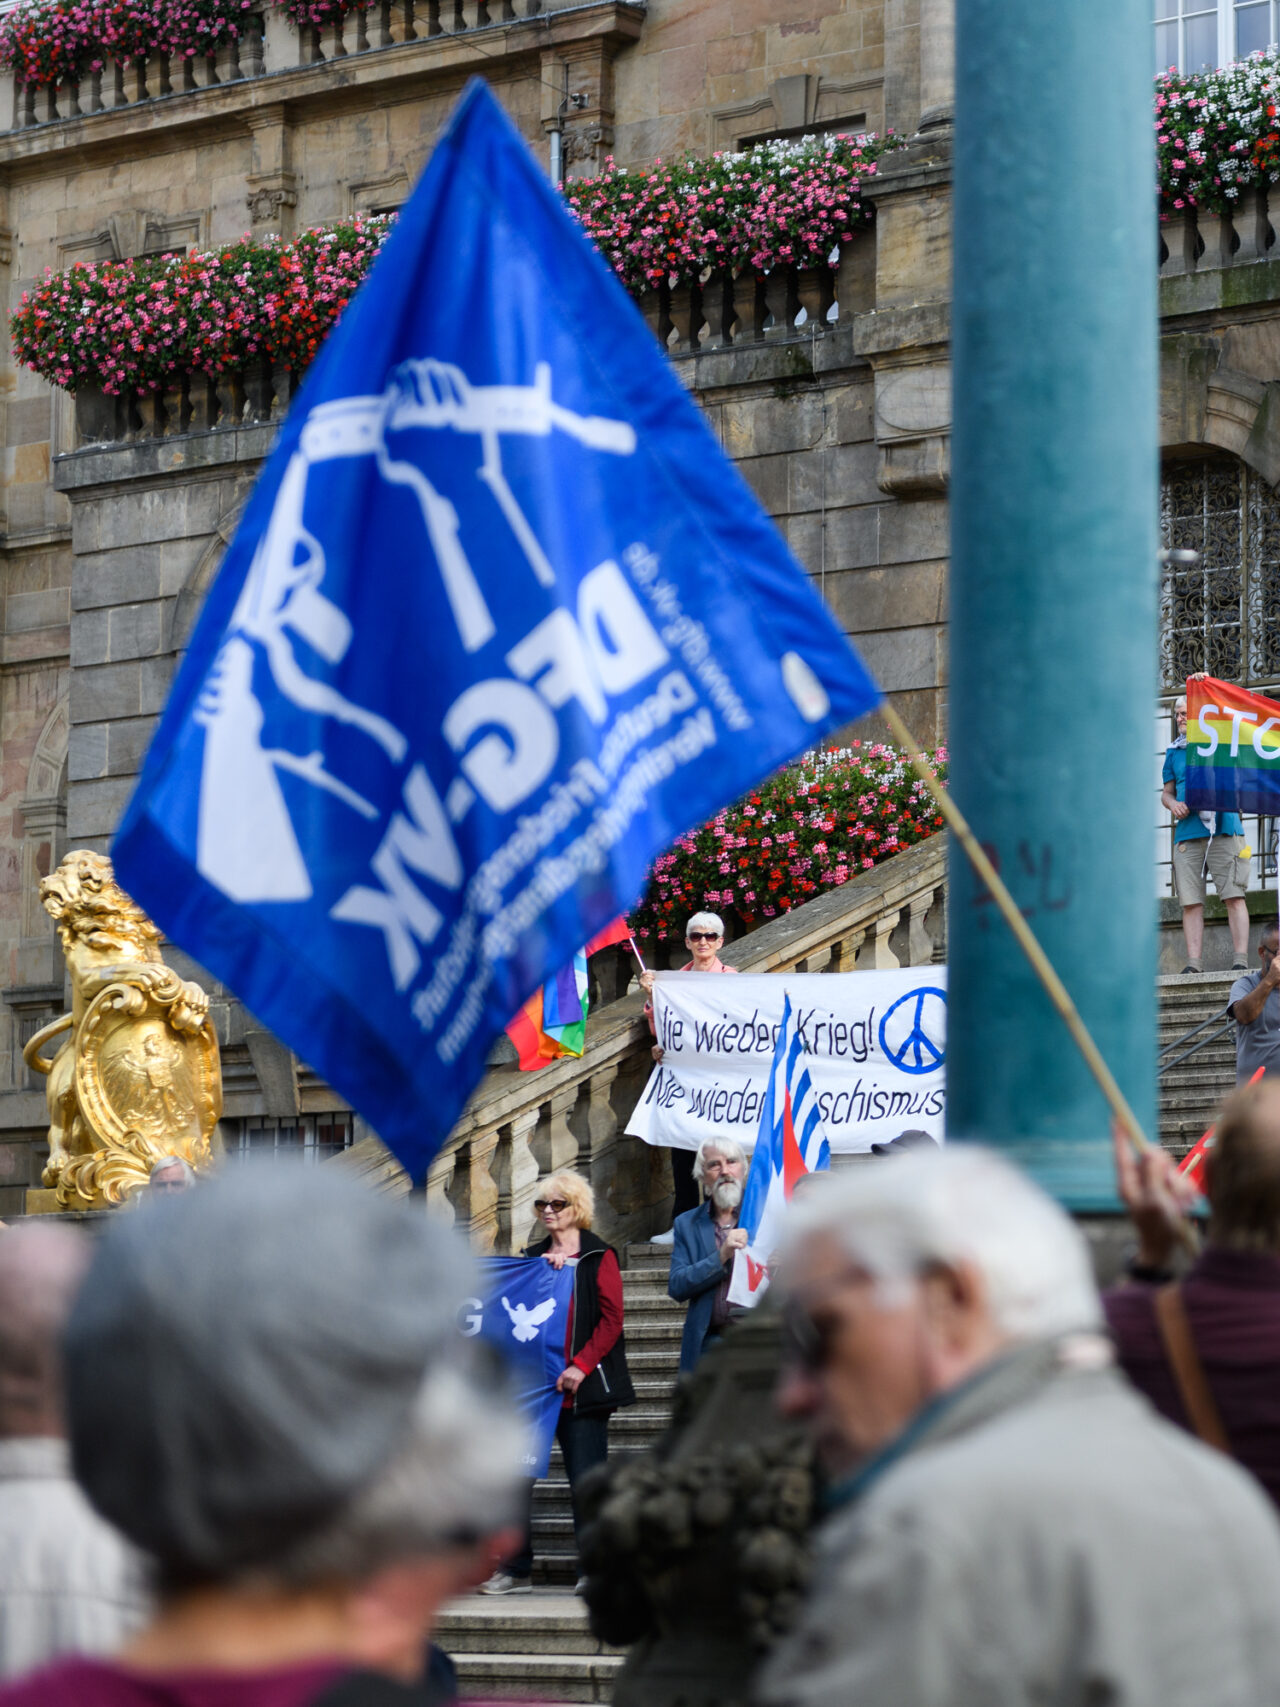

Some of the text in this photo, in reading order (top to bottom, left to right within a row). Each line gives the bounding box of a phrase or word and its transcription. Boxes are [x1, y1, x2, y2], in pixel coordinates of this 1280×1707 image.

[695, 1009, 783, 1053] wieder
[796, 1006, 875, 1063] Krieg!
[815, 1079, 945, 1124] schismus
